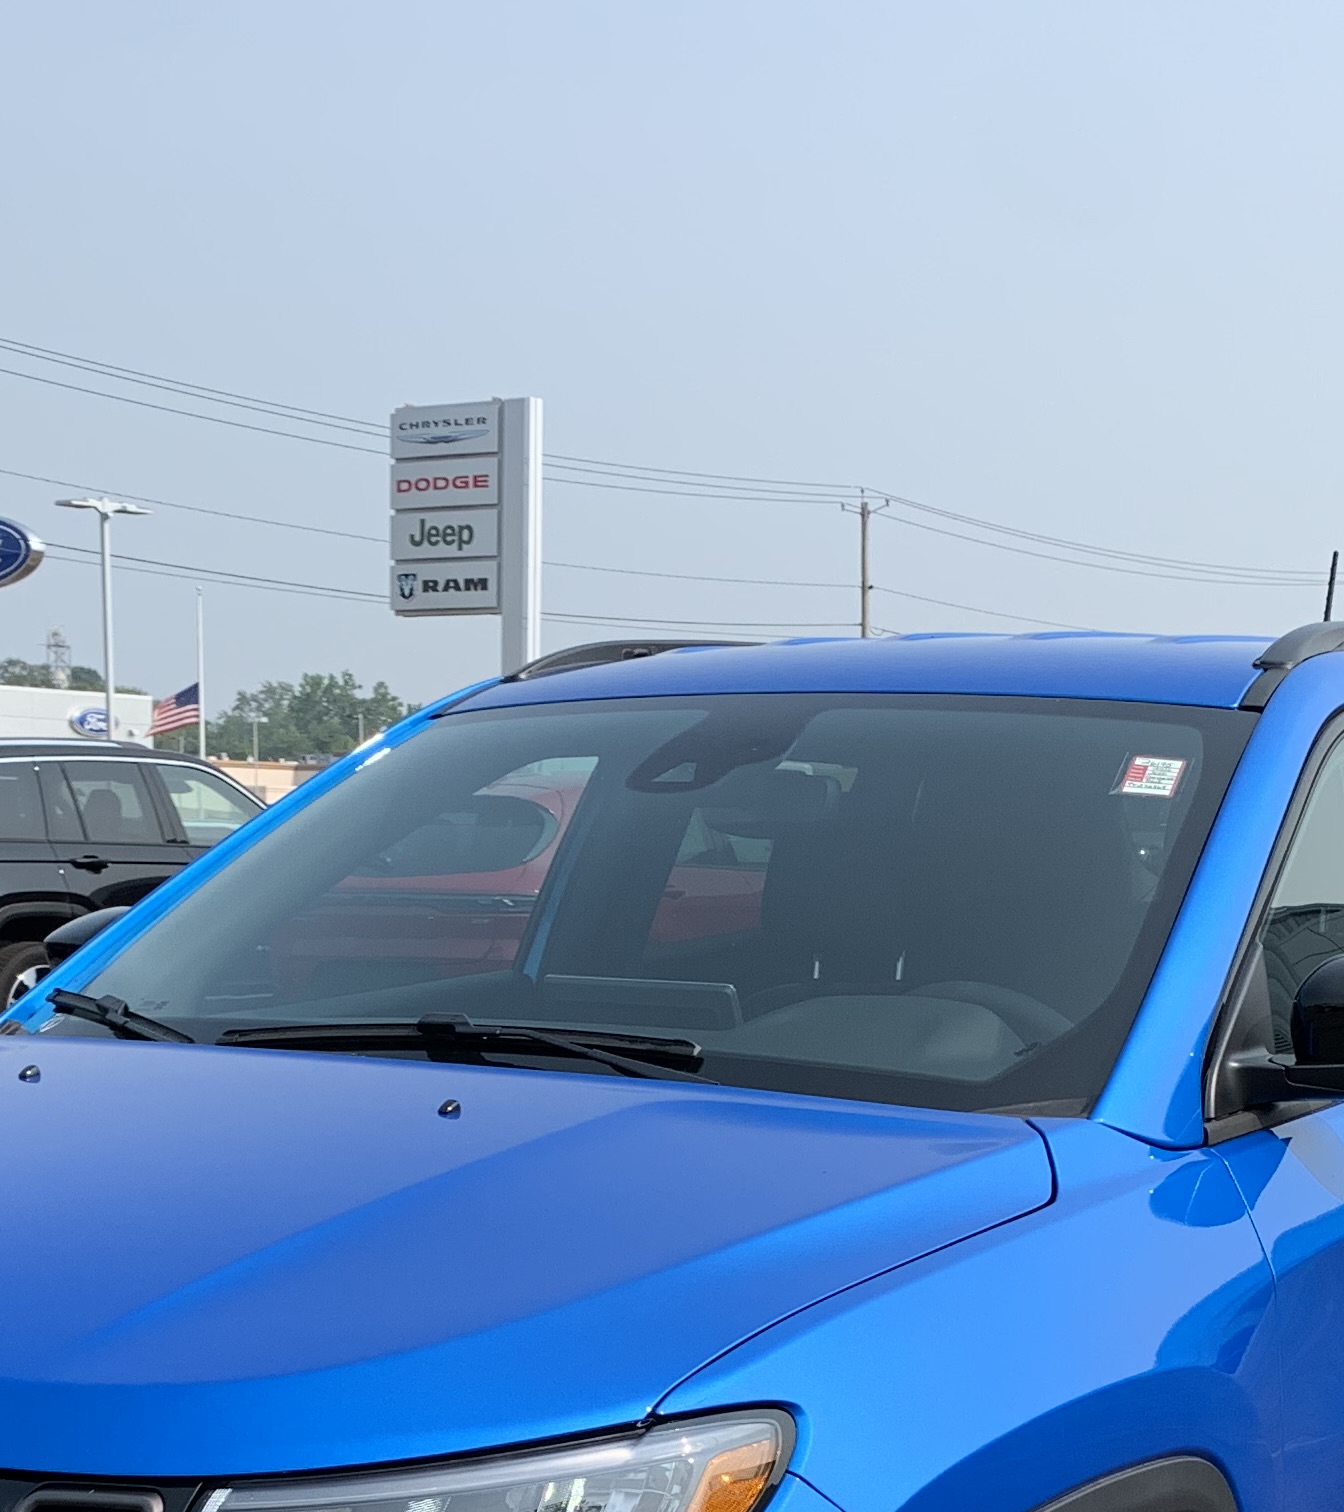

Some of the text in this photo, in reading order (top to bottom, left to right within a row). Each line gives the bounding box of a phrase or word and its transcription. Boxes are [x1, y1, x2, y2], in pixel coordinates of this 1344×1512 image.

[399, 417, 487, 430] CHRYSLER
[397, 475, 489, 493] DODGE
[410, 518, 474, 551] Jeep
[422, 578, 488, 593] RAM
